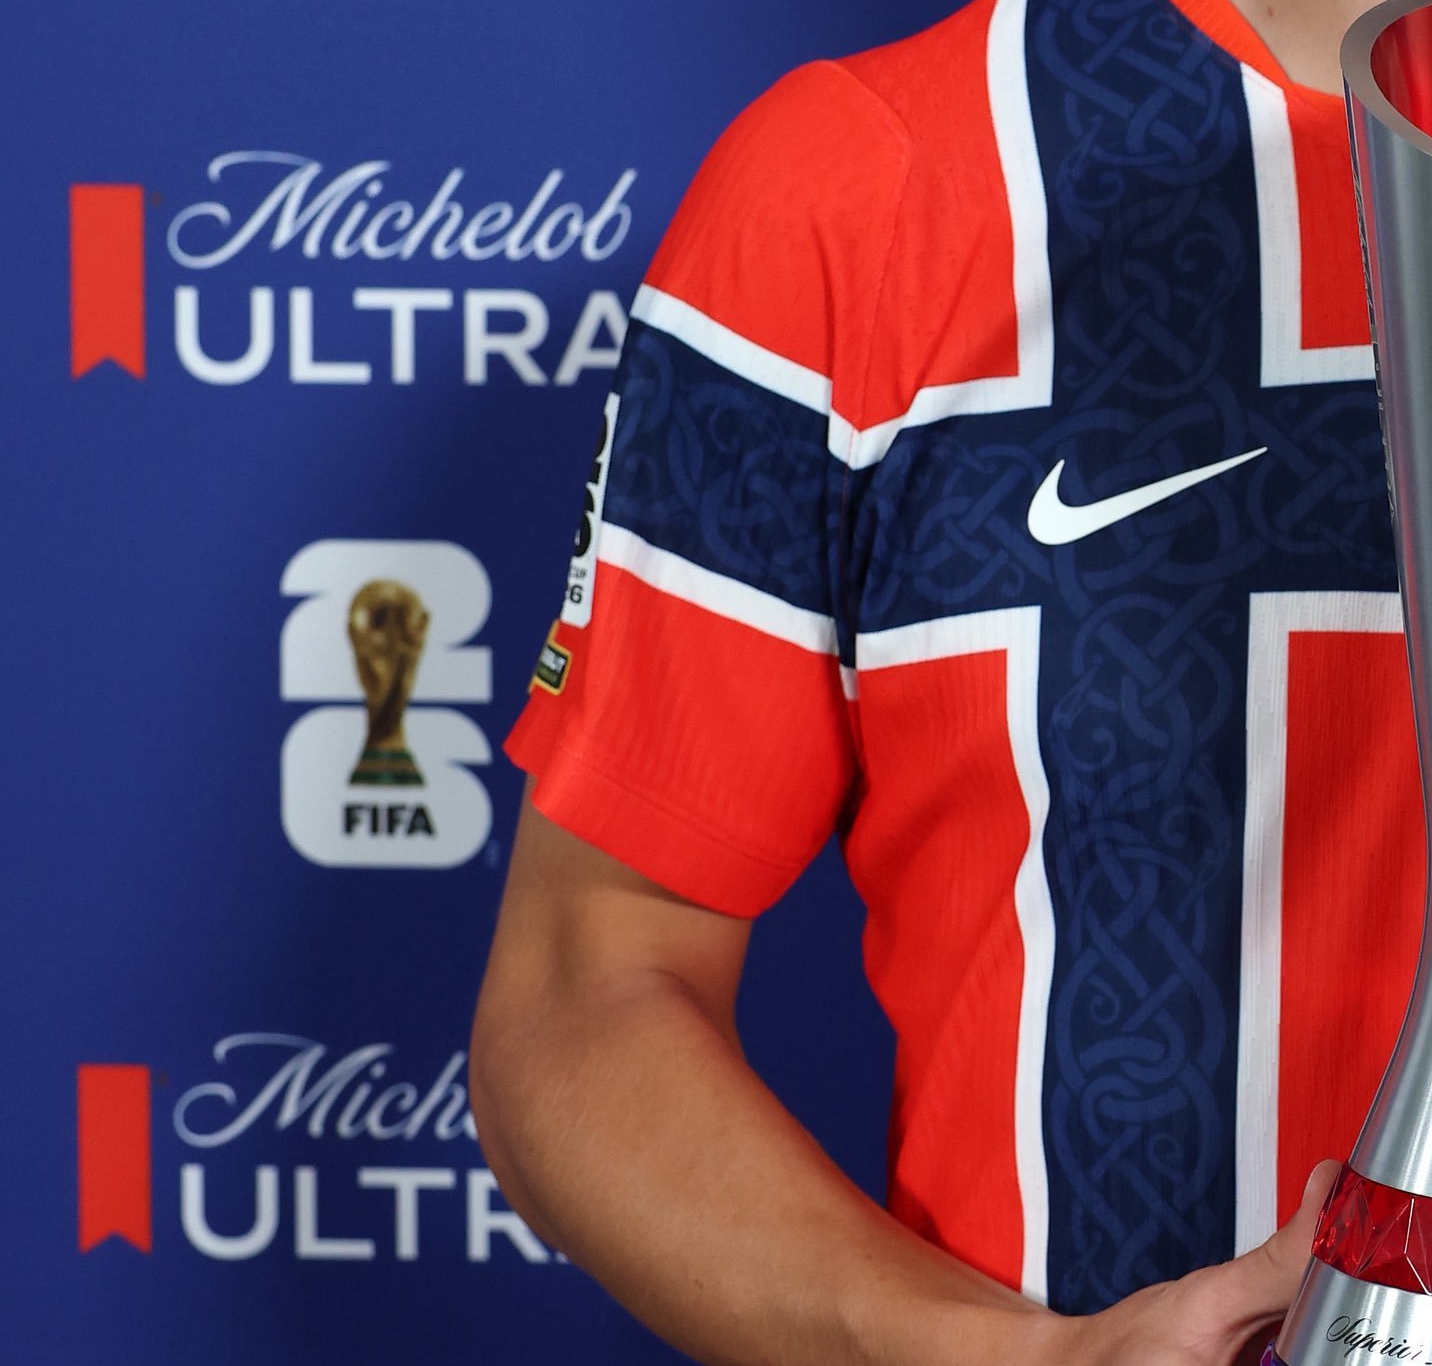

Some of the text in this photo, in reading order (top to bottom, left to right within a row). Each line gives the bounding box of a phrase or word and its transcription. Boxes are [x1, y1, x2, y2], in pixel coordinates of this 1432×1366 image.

[168, 151, 637, 269] Michelob
[174, 286, 628, 386] ULTRA
[342, 803, 436, 838] FIFA
[173, 1033, 478, 1148] Mich
[180, 1163, 570, 1263] ULTR
[1326, 1315, 1426, 1363] Superior
